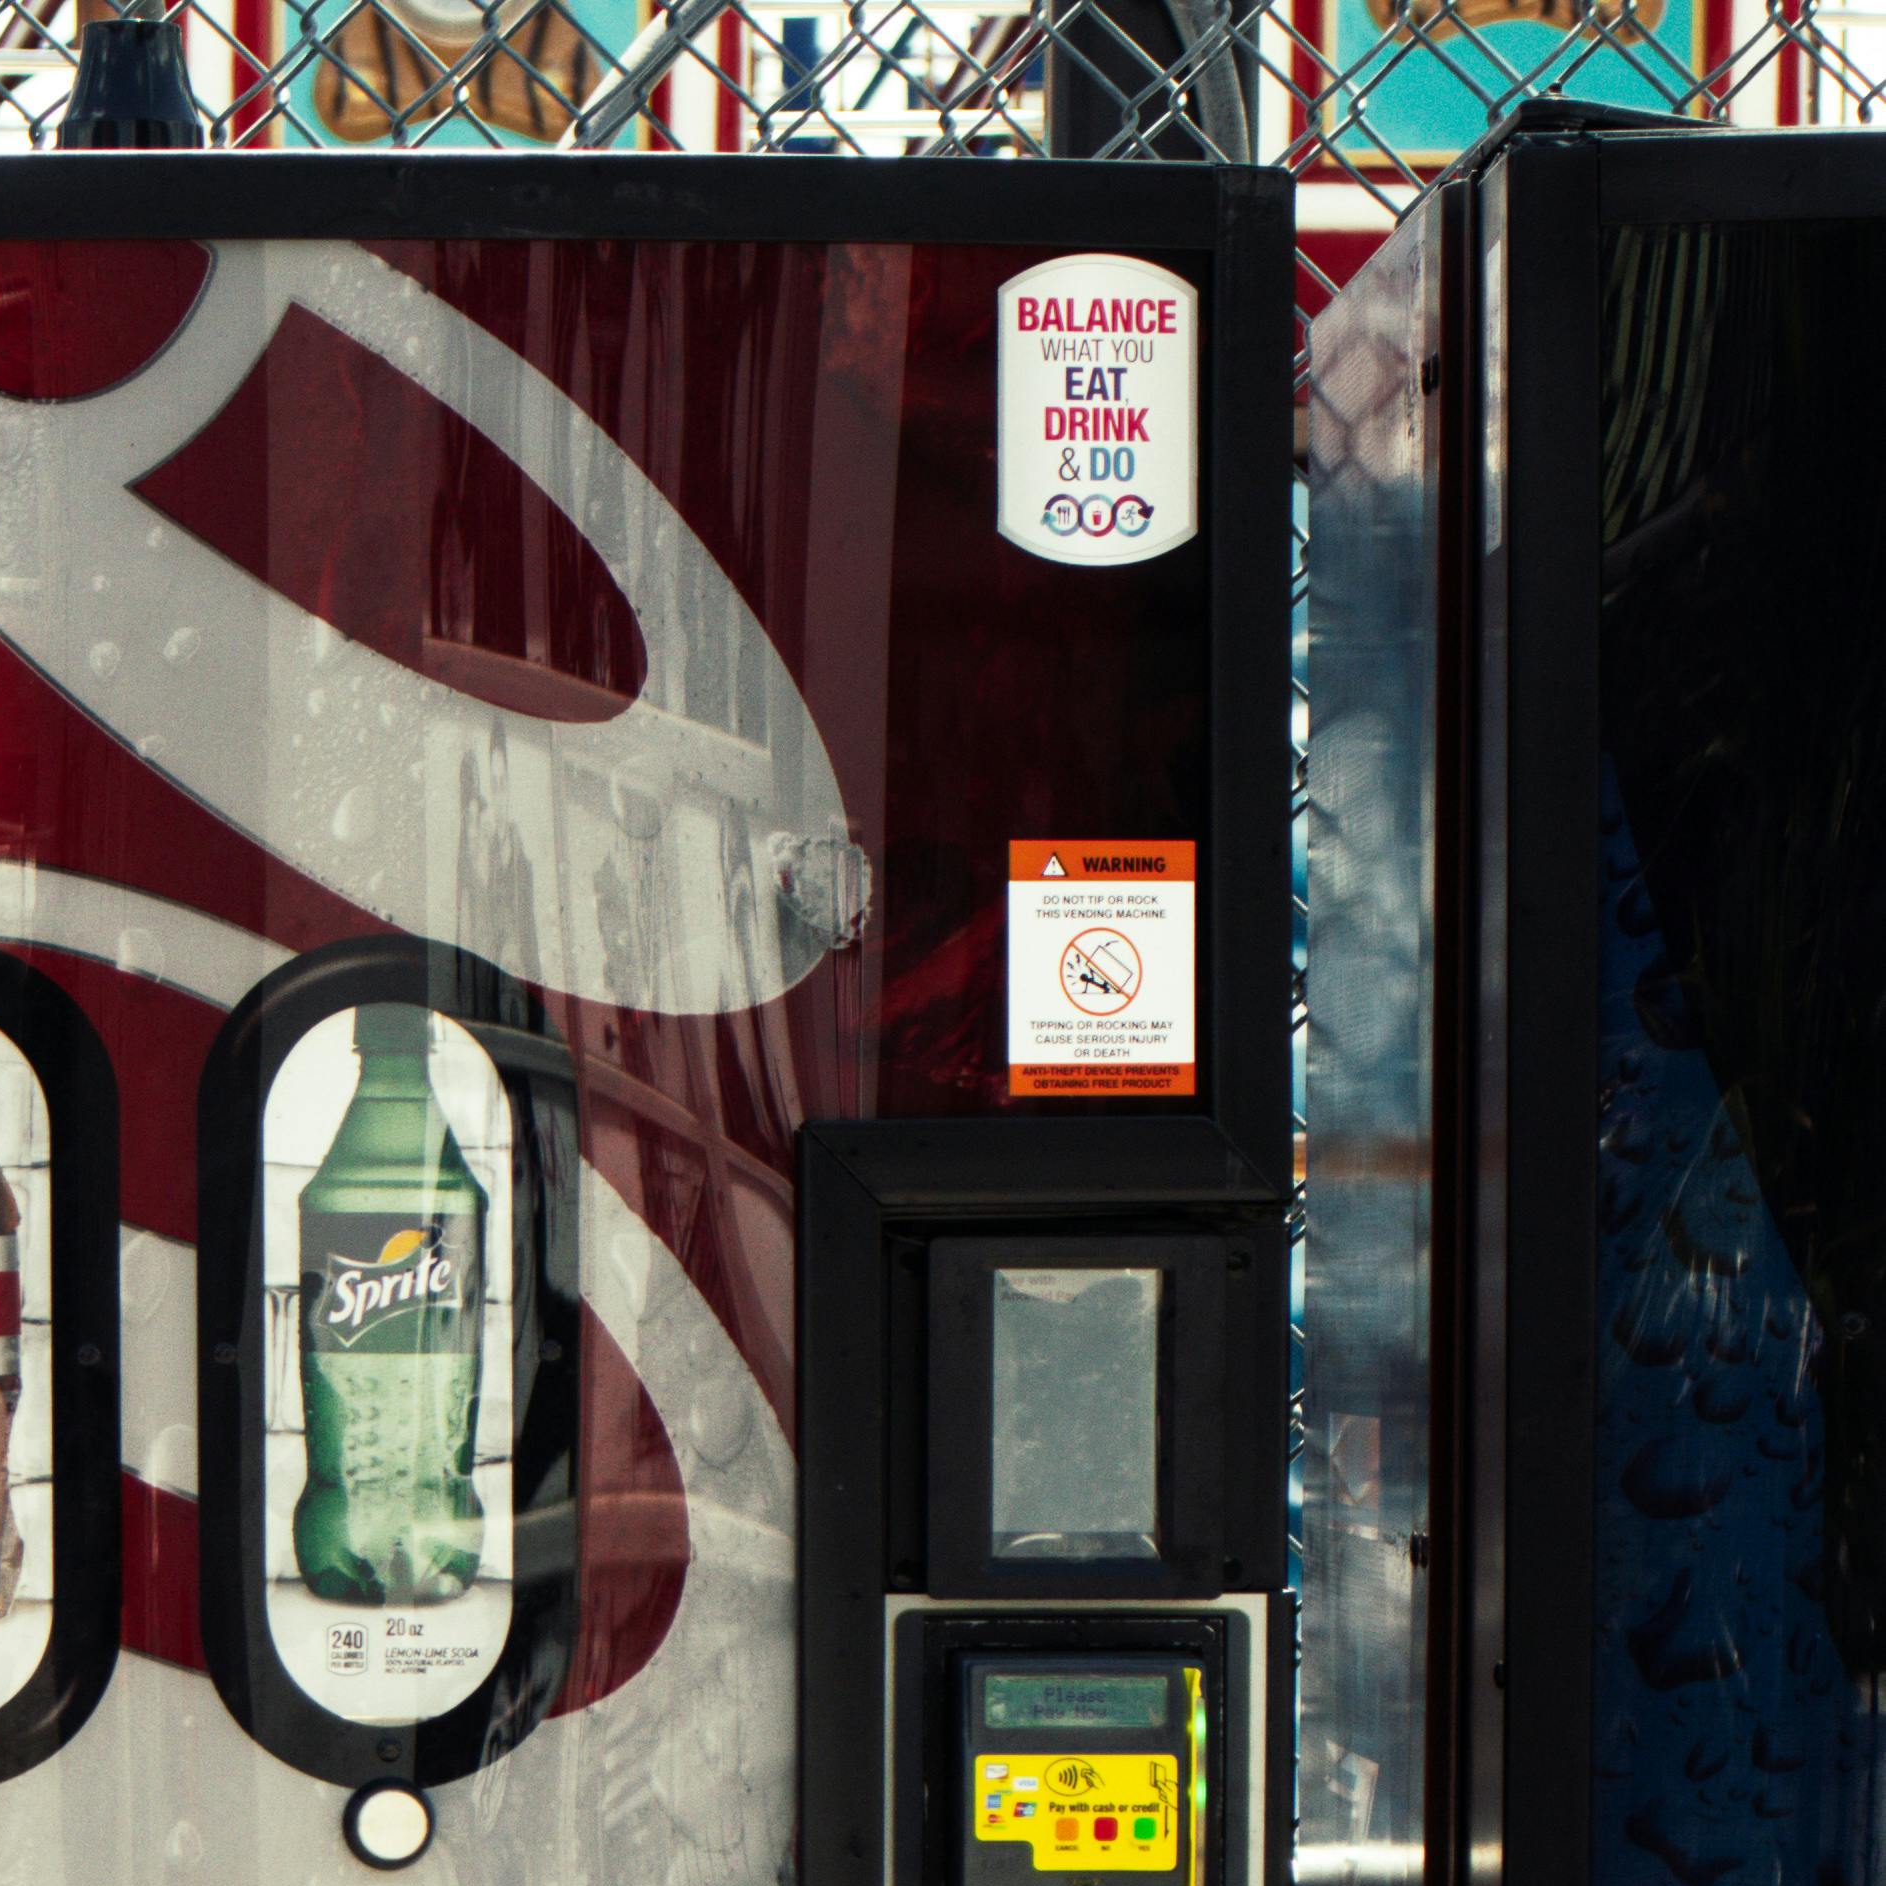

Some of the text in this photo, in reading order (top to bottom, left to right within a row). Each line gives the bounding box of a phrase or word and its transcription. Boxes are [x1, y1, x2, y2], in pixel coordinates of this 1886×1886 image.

[1017, 297, 1177, 334] BALANCE
[1041, 338, 1154, 363] WHAT YOU
[1065, 366, 1129, 405] EAT,
[1045, 406, 1150, 442] DRINK
[1058, 447, 1135, 481] & DO
[1082, 856, 1167, 873] WARNING
[1043, 895, 1159, 905] DO NOT TIP OR ROCK
[1036, 909, 1166, 919] THIS VENDING MACHINE
[1030, 1021, 1173, 1030] TIPPING OR ROCKING MAY
[1035, 1034, 1167, 1044] CAUSE SERIOUS INJURY
[1074, 1048, 1130, 1057] OR DEATH
[1085, 1066, 1123, 1076] DEVICE
[1125, 1066, 1179, 1075] PREVENTS
[1033, 1079, 1172, 1089] OBTAINING FREE PRODUCT
[328, 1249, 451, 1327] Sprite
[386, 1618, 424, 1636] 20 oz
[331, 1630, 363, 1649] 240
[452, 1648, 479, 1658] SODA
[1044, 1686, 1107, 1703] Please
[1049, 1802, 1160, 1814] Pay with cash or credit
